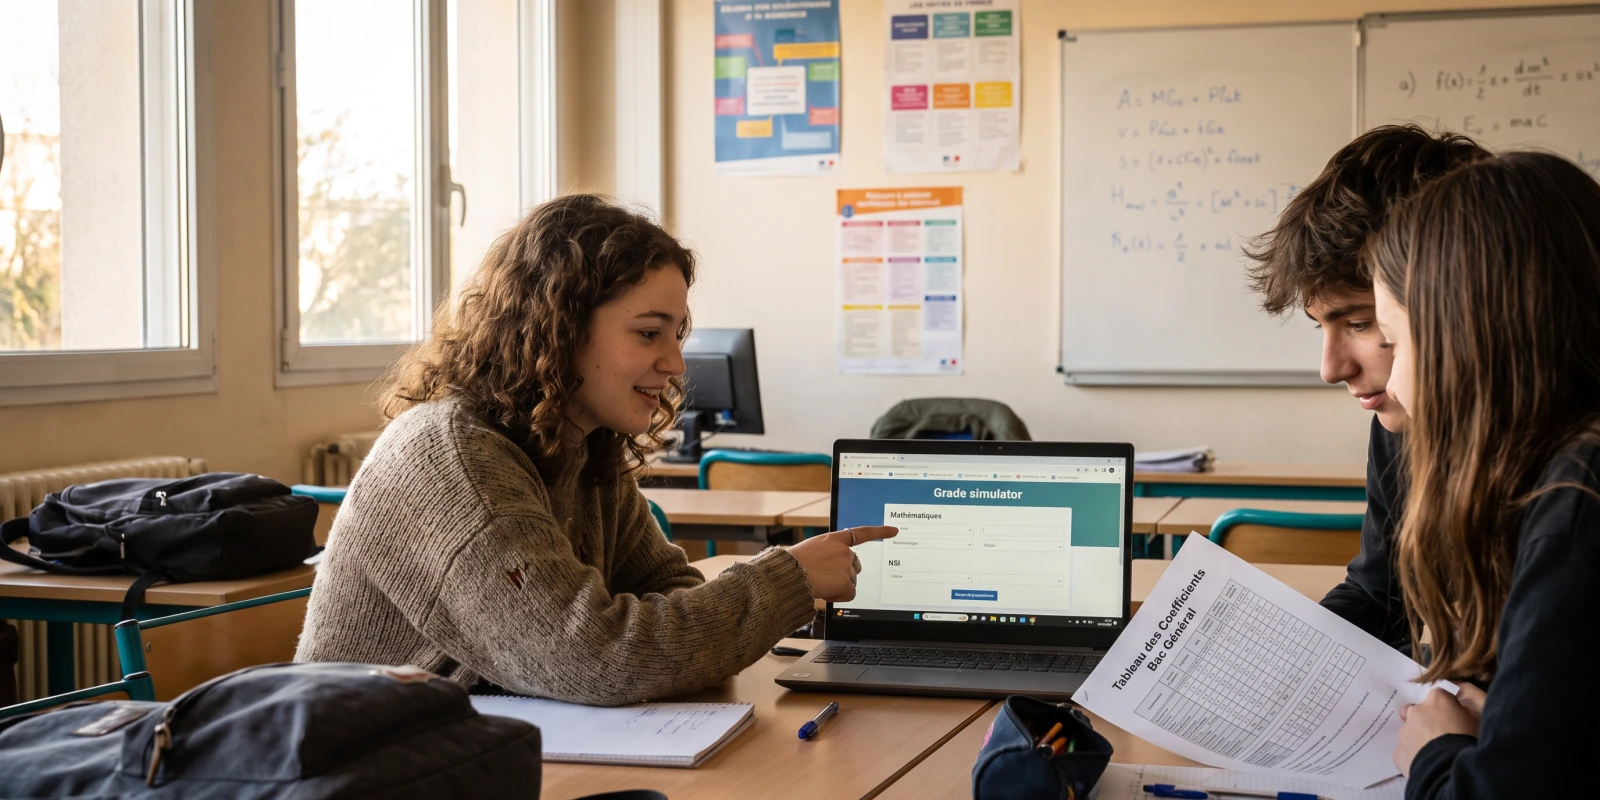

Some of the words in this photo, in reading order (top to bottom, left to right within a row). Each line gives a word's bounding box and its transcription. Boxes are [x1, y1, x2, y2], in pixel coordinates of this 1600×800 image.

[933, 487, 967, 499] Grade
[969, 488, 1023, 500] simulator
[890, 511, 942, 520] Mathématiques
[888, 559, 901, 567] NSI
[1112, 652, 1147, 690] Tableau
[1145, 631, 1162, 652] des
[1158, 569, 1206, 630] Coefficients
[1147, 651, 1167, 672] Bac
[1163, 607, 1197, 650] Général
